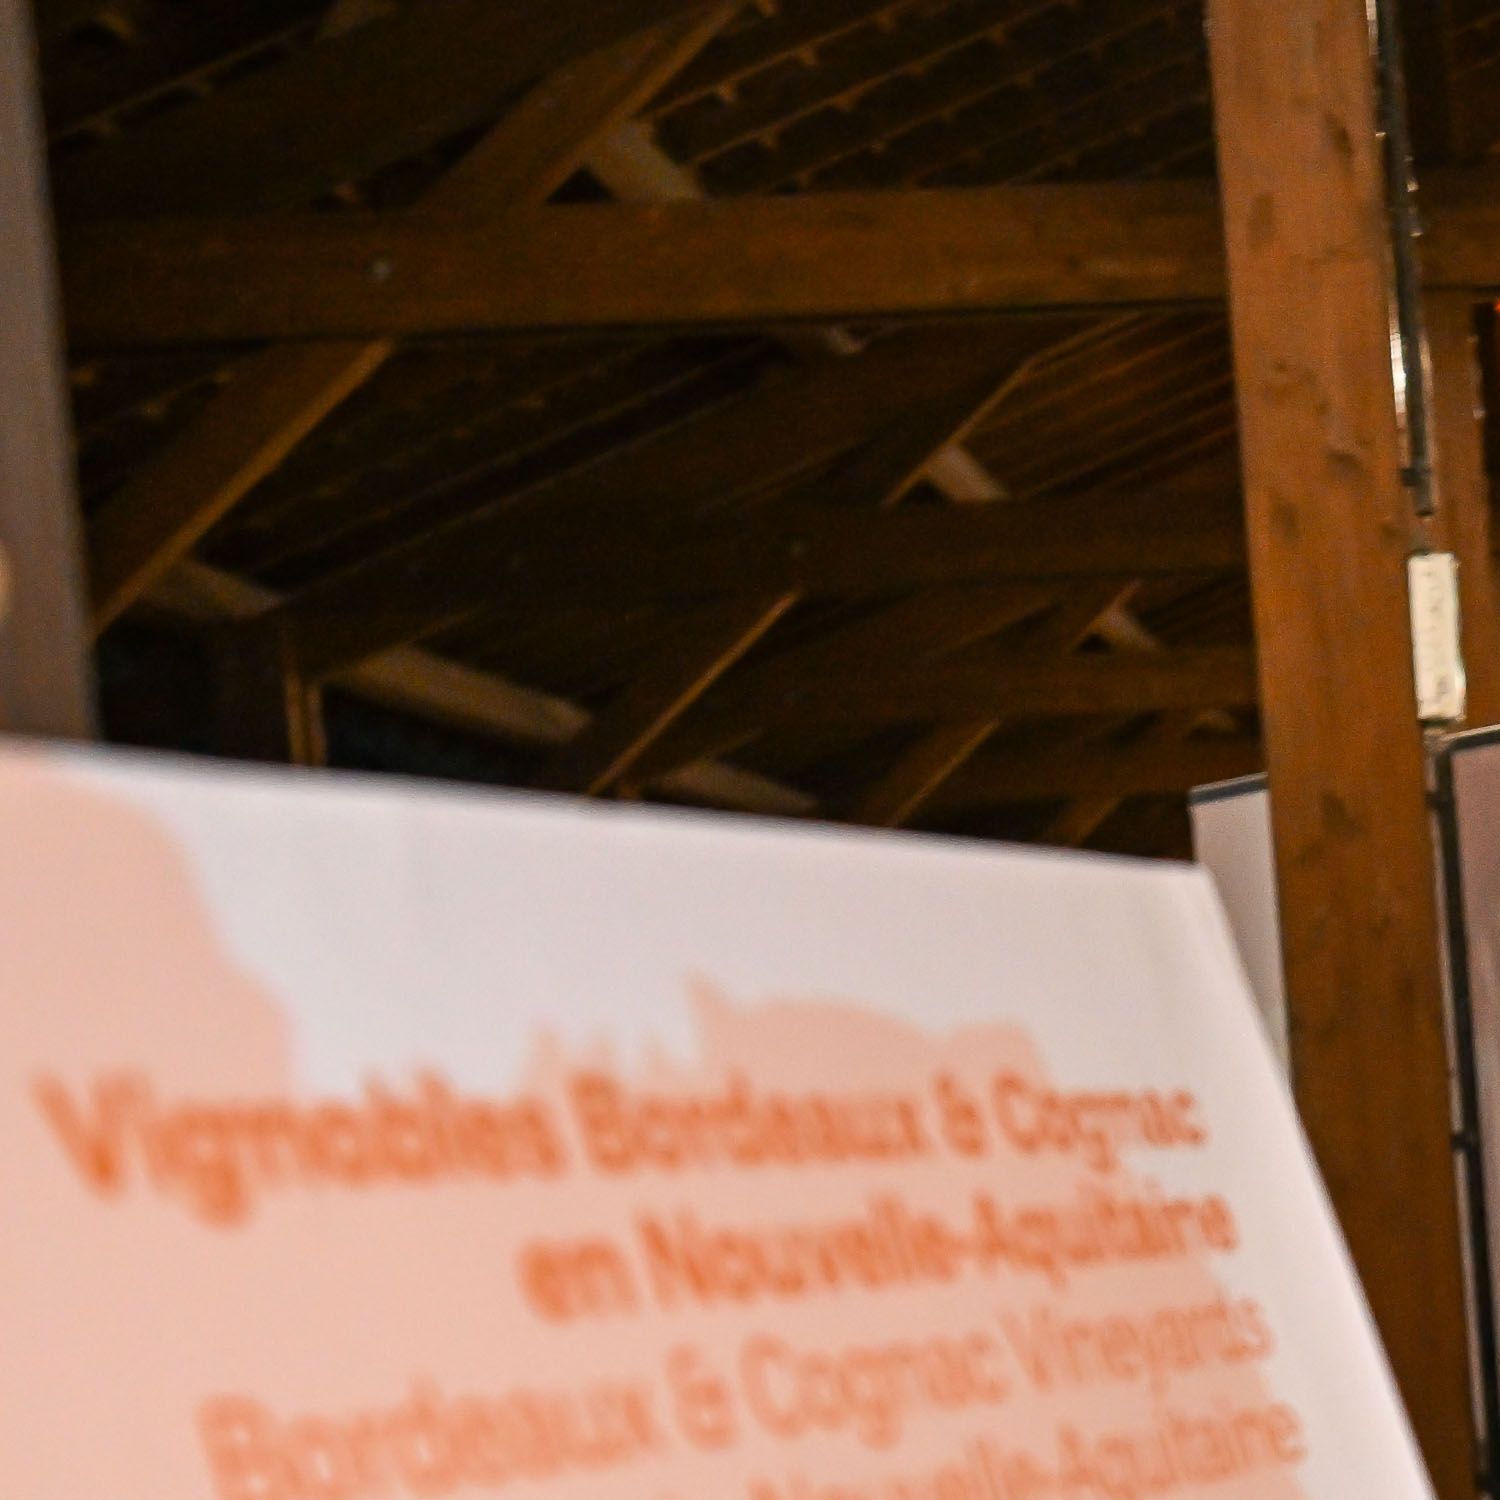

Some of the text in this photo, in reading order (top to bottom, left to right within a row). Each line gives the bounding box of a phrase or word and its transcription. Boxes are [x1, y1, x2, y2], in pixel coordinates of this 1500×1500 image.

[572, 1068, 930, 1178] Bordeaux
[996, 1074, 1208, 1173] Cognac
[514, 1180, 1240, 1326] en Nouvelle-Aquitaine
[738, 1332, 1010, 1452] Cognac
